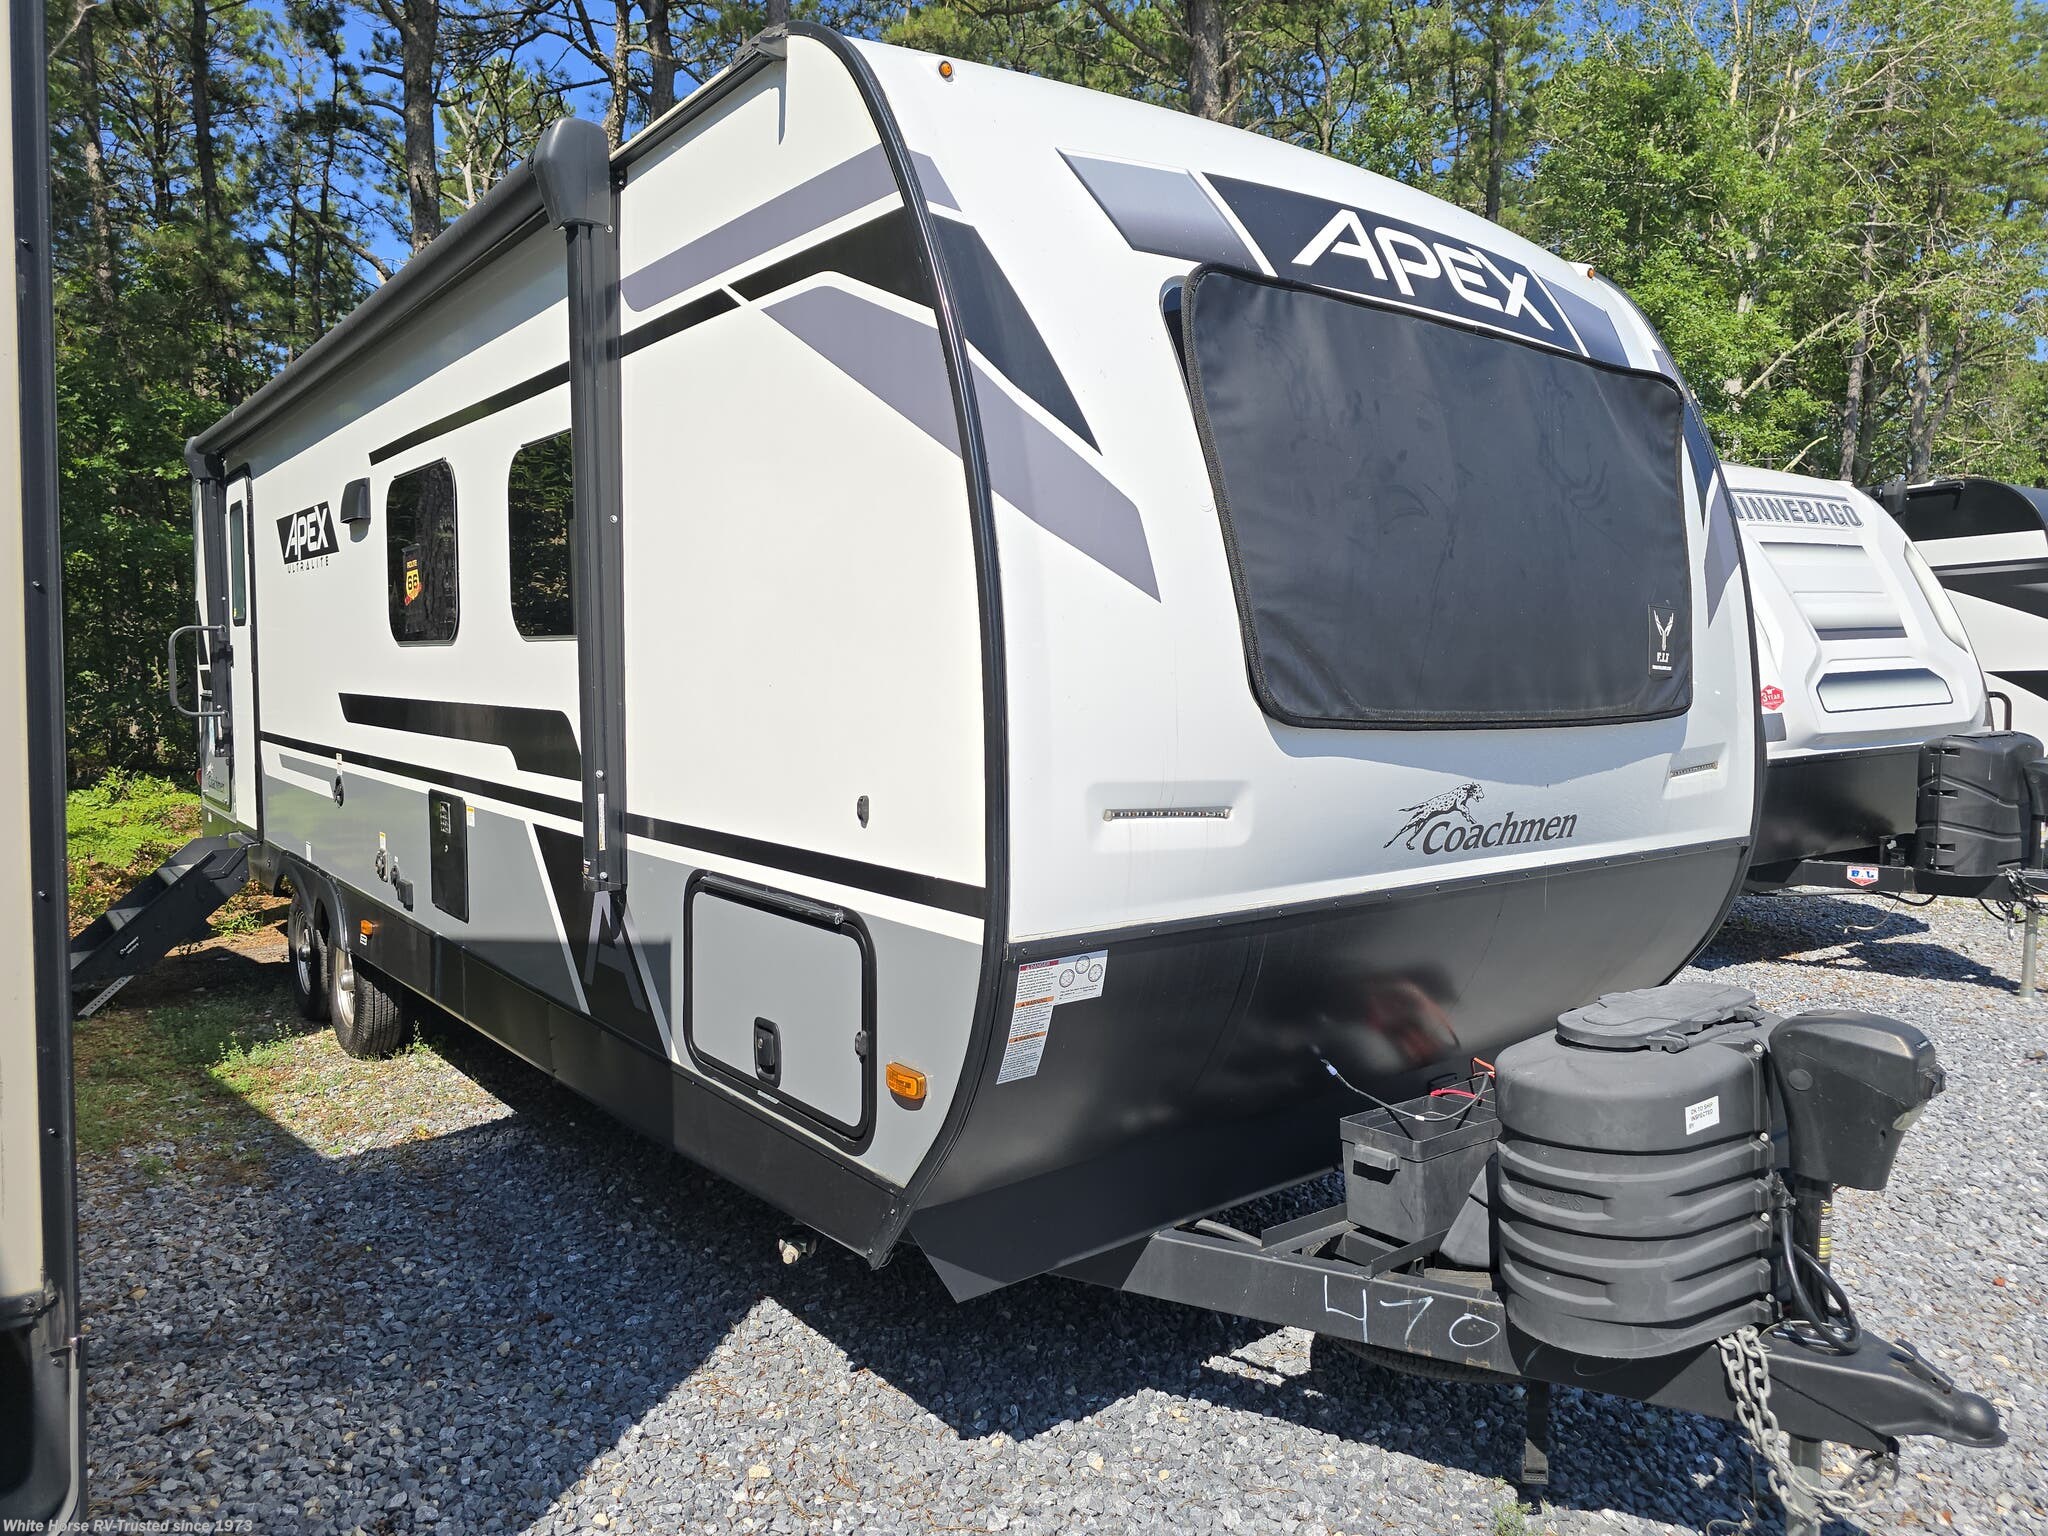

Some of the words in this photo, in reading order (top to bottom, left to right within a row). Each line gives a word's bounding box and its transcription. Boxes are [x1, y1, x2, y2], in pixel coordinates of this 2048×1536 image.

[1291, 209, 1554, 331] APEX
[285, 506, 329, 561] APEX
[287, 556, 330, 574] ULTRALITE
[407, 574, 418, 591] 66
[1761, 690, 1769, 703] 3
[1422, 811, 1578, 855] Coachmen
[1323, 1275, 1500, 1347] 470
